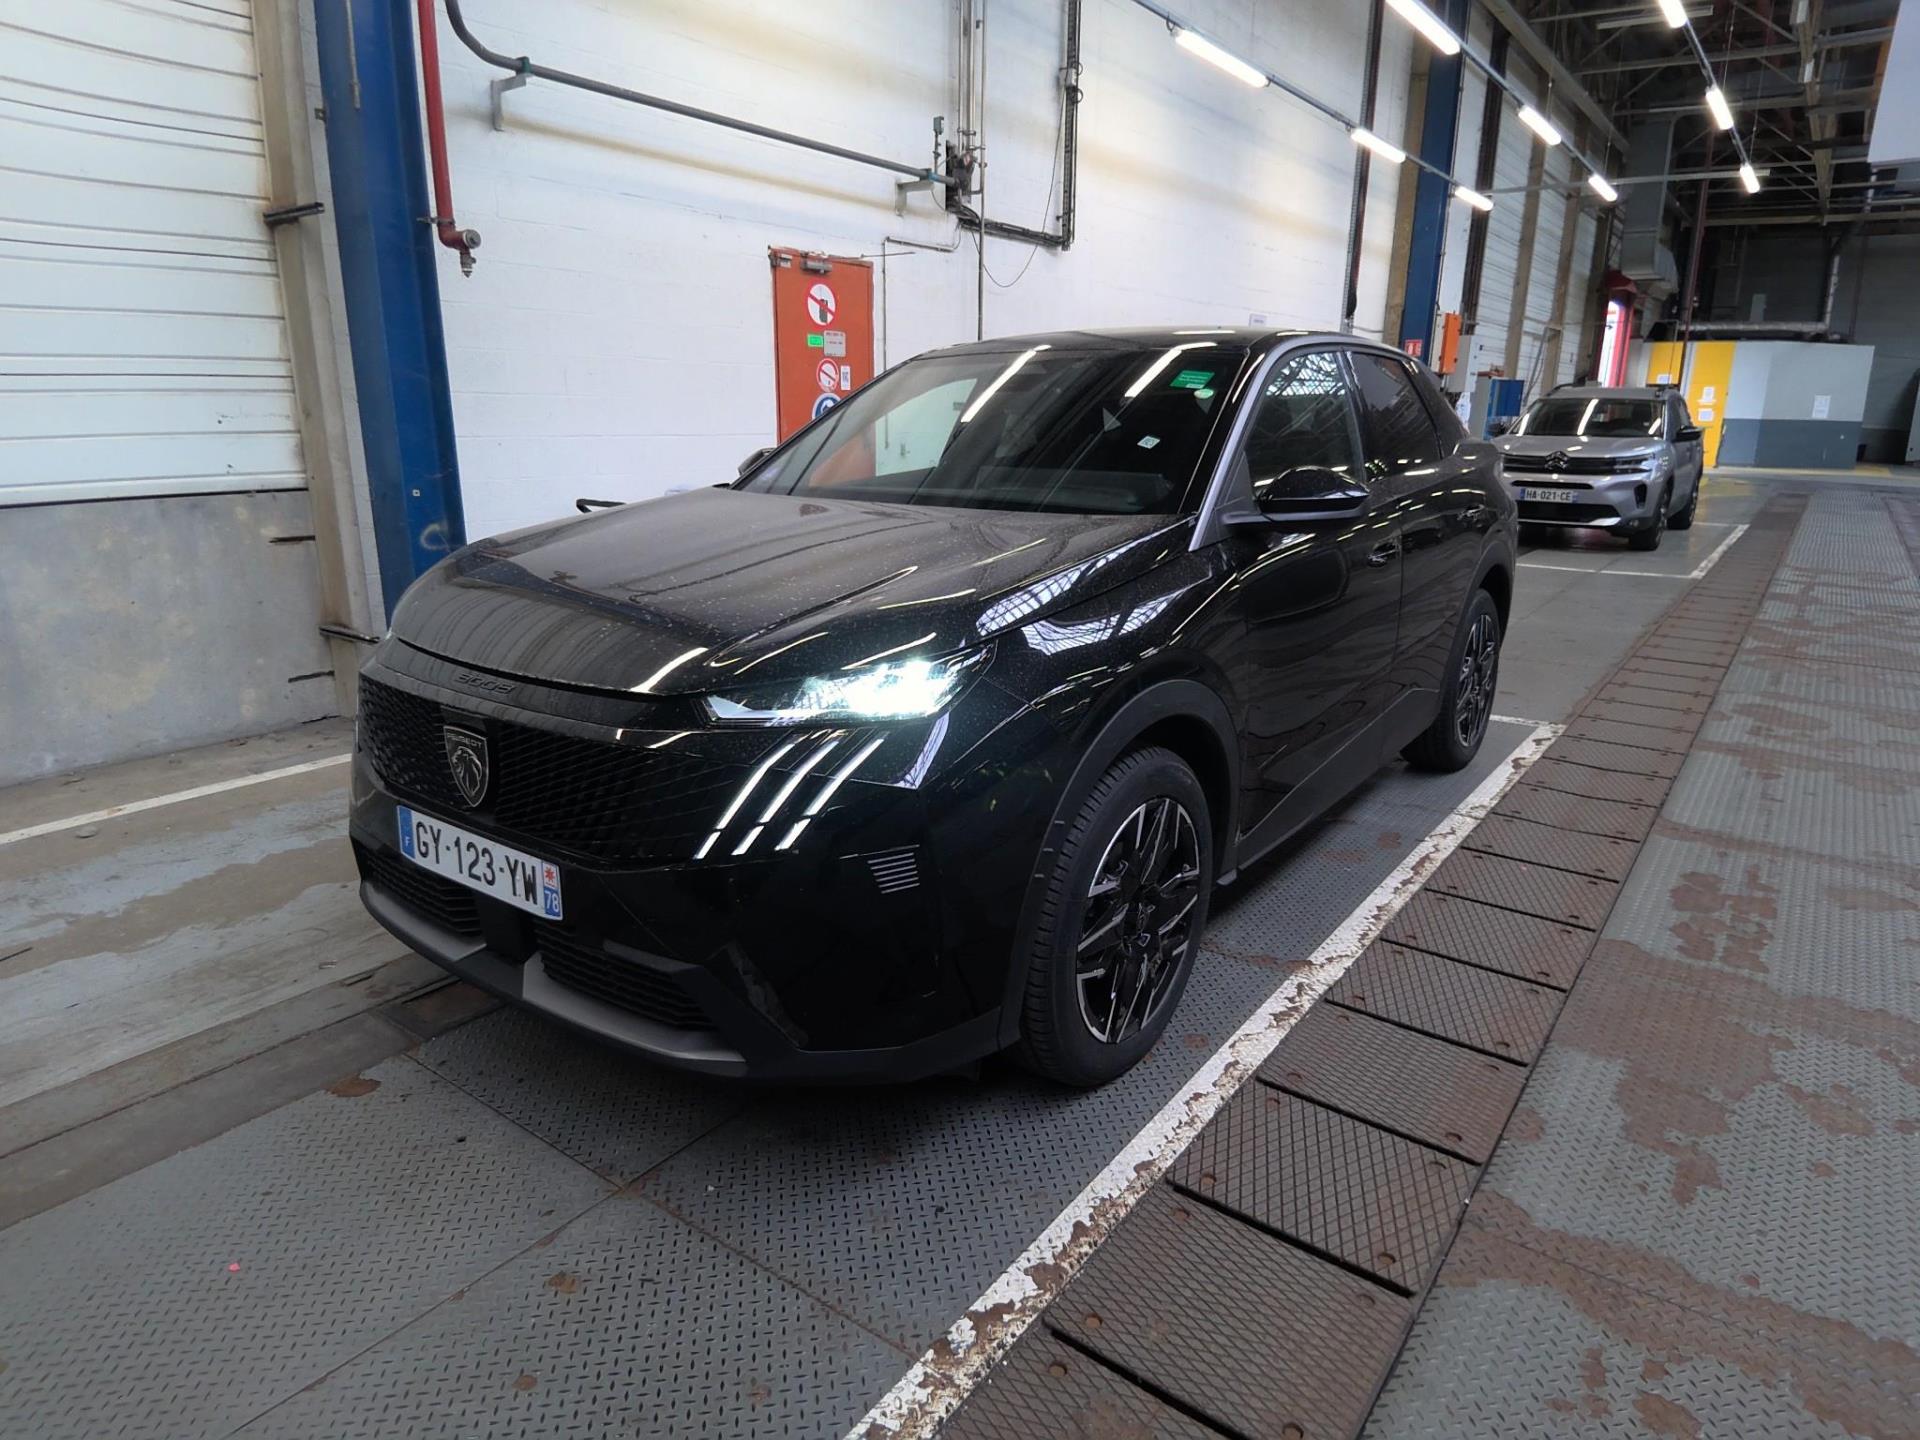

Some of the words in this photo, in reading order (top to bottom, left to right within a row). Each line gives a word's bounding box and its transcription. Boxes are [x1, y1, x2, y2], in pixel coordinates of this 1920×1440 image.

[1526, 490, 1572, 501] HA-021-CE
[405, 836, 411, 847] F
[416, 821, 538, 906] GY-123-YW
[544, 889, 560, 913] 78
